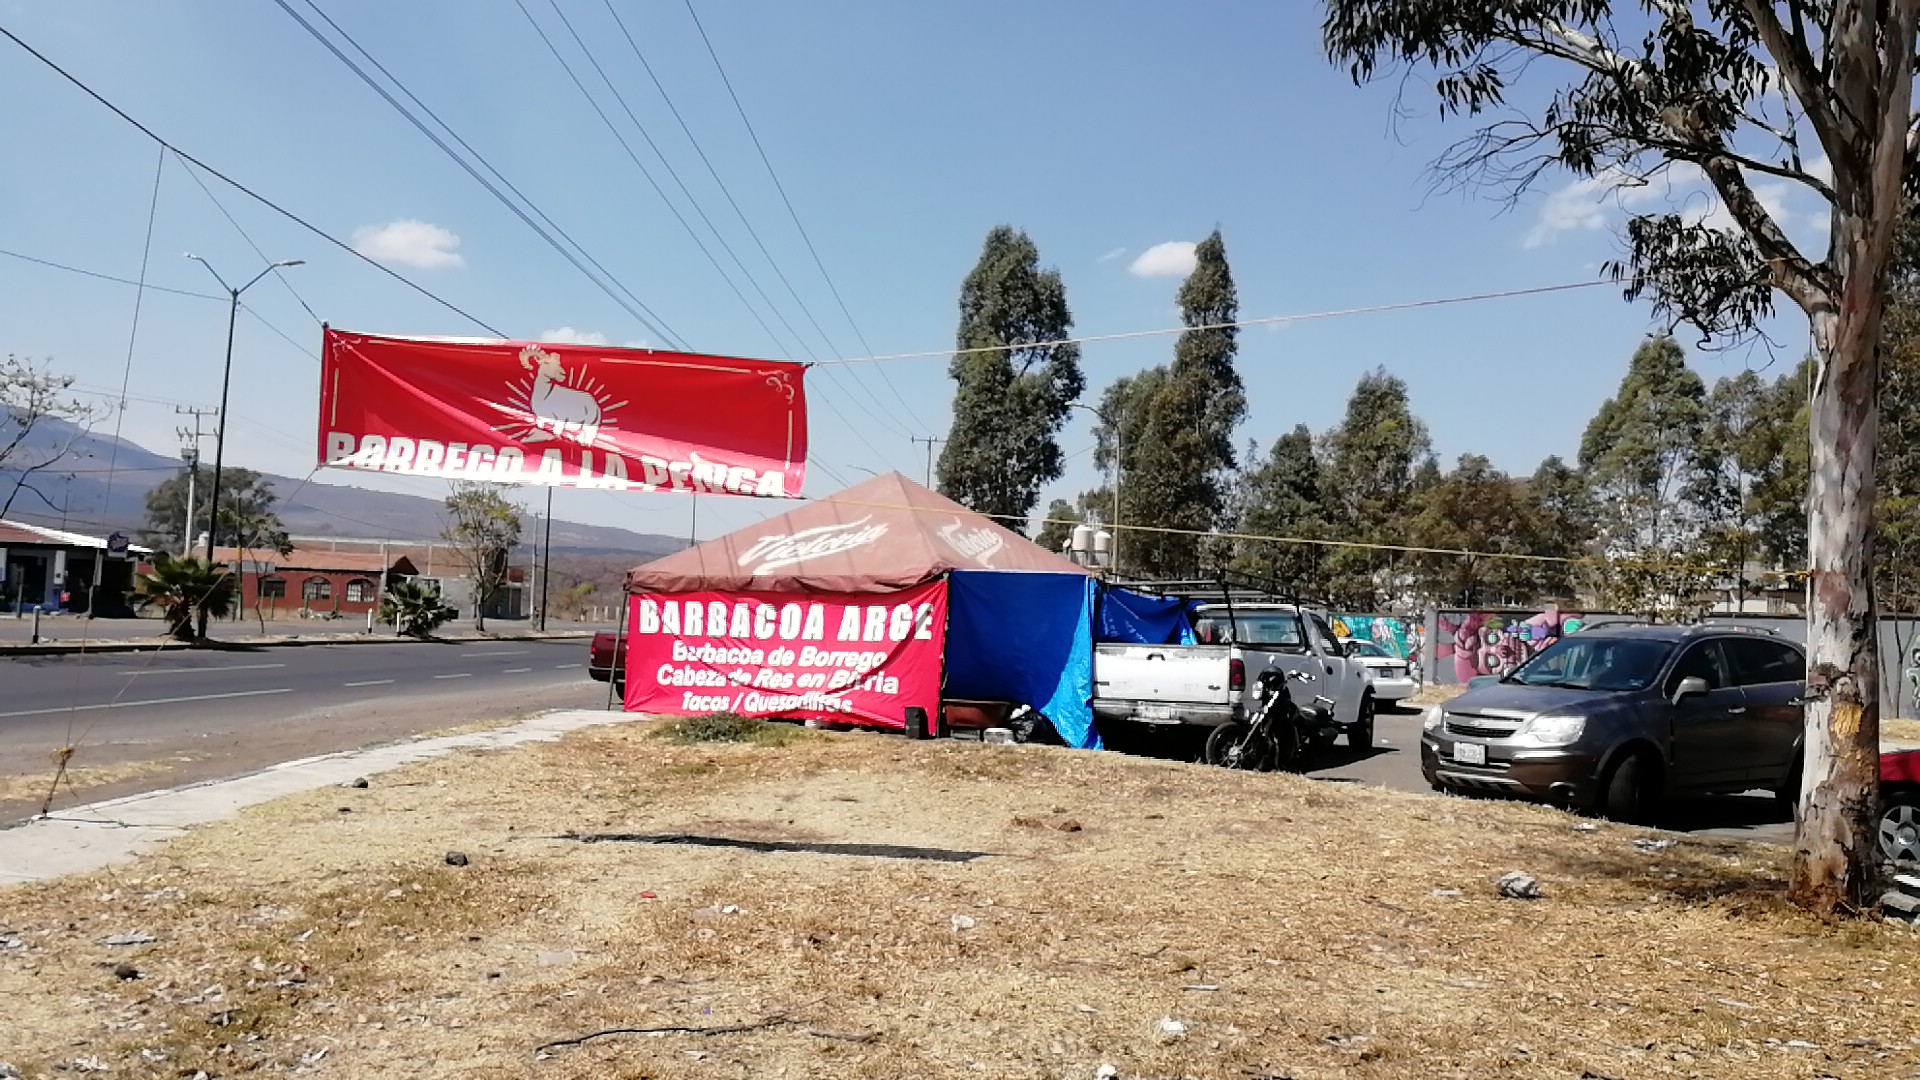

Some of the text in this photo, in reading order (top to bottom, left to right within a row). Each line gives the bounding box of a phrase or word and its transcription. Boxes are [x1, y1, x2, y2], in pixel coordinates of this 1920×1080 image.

[326, 431, 524, 481] BORREGO
[536, 448, 563, 485] A
[576, 449, 629, 489] LA
[738, 516, 889, 571] Victoria
[639, 600, 934, 642] BARBACOA ARGE
[672, 640, 888, 672] Barbacoa de Borrego
[657, 664, 727, 687] Cabeza
[752, 669, 794, 688] Res
[796, 671, 825, 688] en
[681, 691, 731, 712] Tacos
